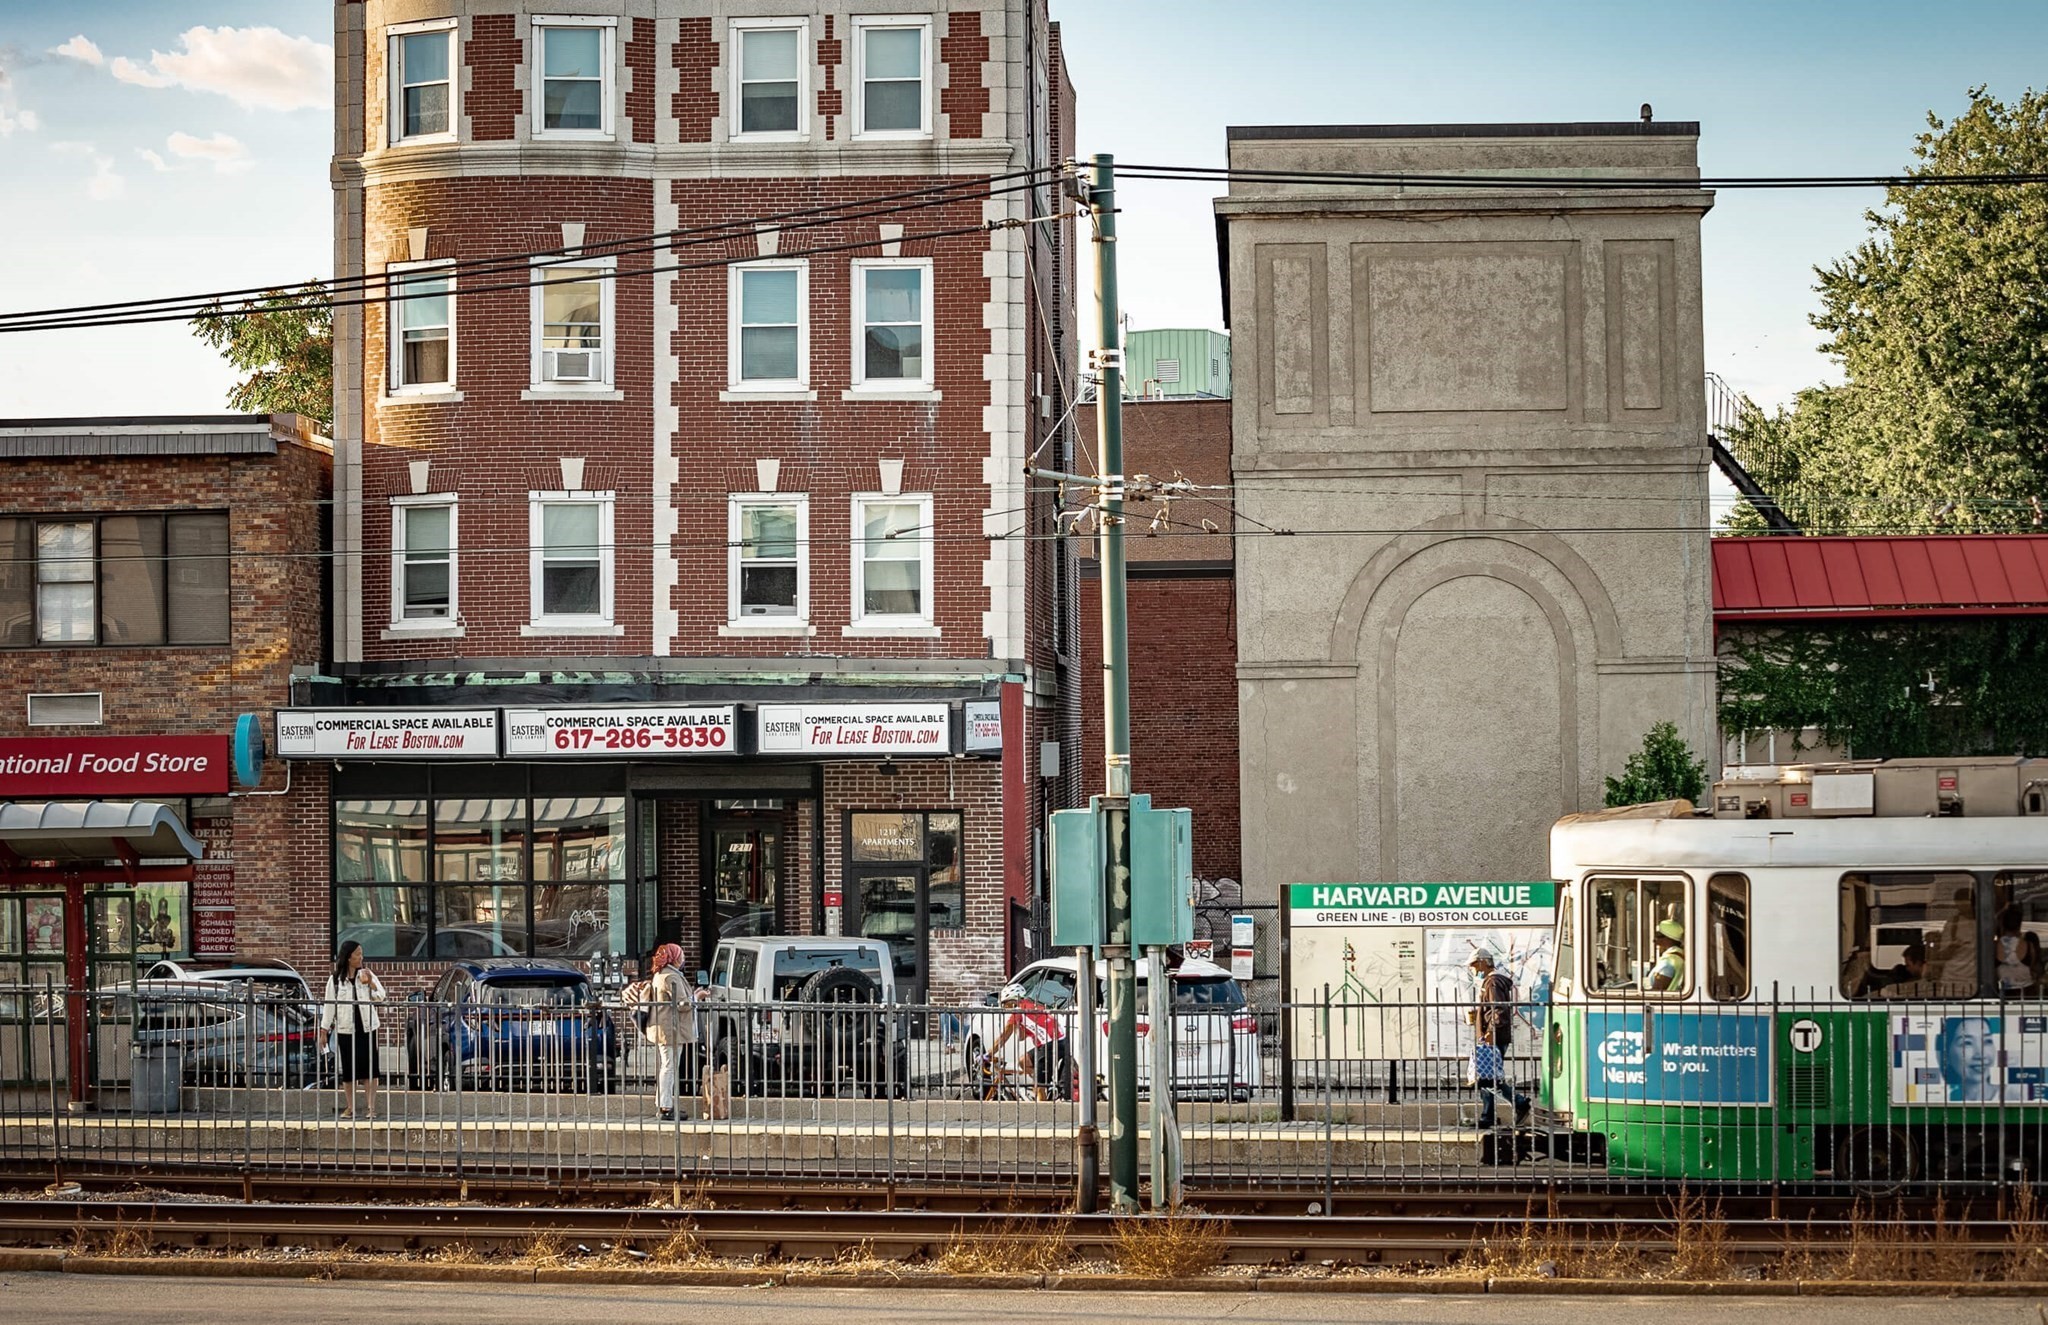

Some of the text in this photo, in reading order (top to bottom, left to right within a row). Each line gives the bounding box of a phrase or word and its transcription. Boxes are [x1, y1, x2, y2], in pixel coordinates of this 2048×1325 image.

[316, 718, 493, 730] COMMERCIAL SPACE AVAILABLE
[546, 715, 731, 728] COMMERCIAL SPACE AVAILABLE
[805, 715, 944, 724] COMMERCIAL SPACE AVAILABLE
[281, 726, 313, 736] EASTERN
[512, 725, 545, 735] EASTERN
[766, 722, 800, 732] EASTERN
[554, 727, 726, 749] 617-286-3830
[78, 752, 140, 773] Food
[143, 752, 208, 772] Store
[195, 829, 234, 837] DELIC
[1312, 886, 1531, 906] HARVARD AVENUE
[1316, 913, 1358, 922] GREEN
[1362, 912, 1389, 922] LINE
[1400, 912, 1416, 923] (B)
[1419, 912, 1469, 922] BOSTON
[1472, 911, 1528, 921] COLLEGE
[1795, 1027, 1817, 1047] T
[1663, 1043, 1757, 1056] What matters
[1663, 1060, 1709, 1074] to you.
[1602, 1066, 1647, 1084] News
